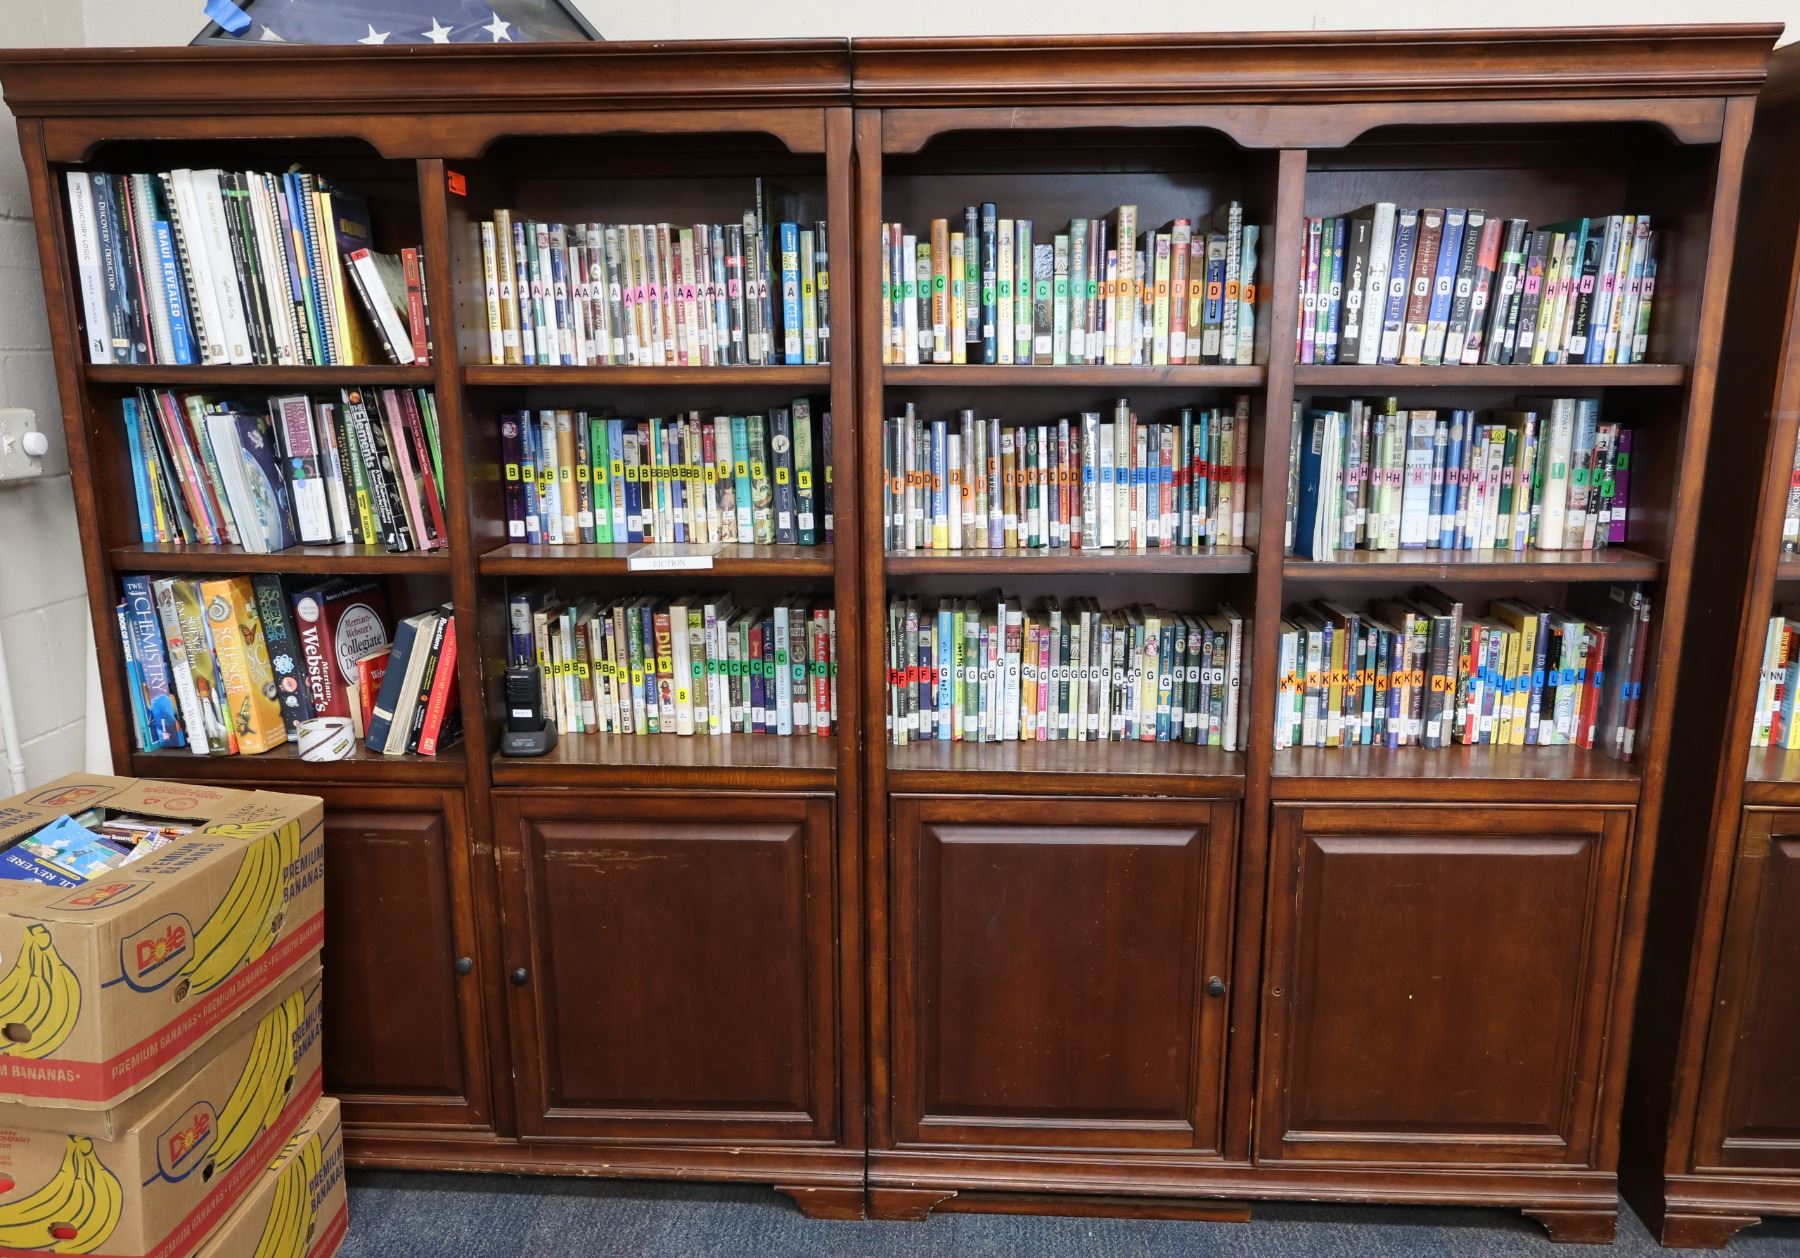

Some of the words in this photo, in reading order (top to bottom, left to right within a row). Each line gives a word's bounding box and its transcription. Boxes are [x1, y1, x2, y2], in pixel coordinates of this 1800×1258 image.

[75, 183, 88, 238] INTRODUCTORY
[1398, 229, 1411, 272] SHADOW
[1462, 230, 1478, 272] BRINGER
[158, 230, 169, 259] MAUI
[164, 263, 180, 317] REVEALED
[732, 283, 738, 293] A
[906, 285, 912, 294] C
[1001, 285, 1008, 293] C
[1088, 285, 1096, 294] C
[1175, 284, 1182, 293] D
[1230, 285, 1237, 294] D
[1372, 282, 1380, 291] G
[1440, 281, 1447, 290] G
[1506, 281, 1512, 290] G
[1562, 282, 1568, 291] H
[1632, 282, 1639, 291] H
[503, 286, 510, 296] A
[557, 287, 563, 296] A
[593, 286, 600, 295] A
[637, 290, 644, 300] A
[686, 289, 693, 299] A
[787, 287, 794, 297] A
[1040, 286, 1047, 295] C
[1146, 291, 1152, 301] D
[1320, 298, 1327, 307] G
[1509, 305, 1518, 324] RIVER
[1576, 314, 1586, 330] Night
[346, 424, 357, 452] FALLACY
[354, 411, 375, 468] Elements
[351, 453, 362, 486] DETECTIVE
[615, 464, 620, 472] B
[686, 468, 692, 477] B
[721, 465, 727, 474] B
[1200, 464, 1207, 473] F
[1361, 468, 1368, 476] H
[525, 469, 531, 478] B
[562, 470, 568, 478] B
[664, 469, 669, 478] B
[779, 471, 786, 480] B
[907, 473, 914, 482] D
[924, 474, 931, 482] D
[1007, 473, 1013, 482] D
[1061, 472, 1067, 481] D
[1104, 471, 1110, 479] E
[1151, 472, 1157, 481] E
[1386, 472, 1392, 481] H
[1434, 472, 1440, 481] H
[1472, 473, 1479, 481] H
[1505, 471, 1511, 480] H
[1577, 473, 1583, 482] J
[963, 488, 969, 497] D
[1605, 485, 1611, 494] J
[267, 590, 286, 640] SCIENCE
[118, 613, 126, 630] BOOK
[345, 616, 371, 628] Merriam-
[121, 631, 127, 639] OF
[346, 624, 372, 637] Webster's
[433, 617, 447, 650] Reactions
[176, 601, 196, 670] ENCYCLOPEDIA
[134, 597, 167, 693] CHEMISTRY
[341, 635, 381, 657] Collegiate
[220, 627, 244, 692] SCIENCE
[303, 626, 326, 712] Webster's
[555, 666, 560, 674] B
[580, 667, 586, 675] B
[610, 665, 615, 674] B
[647, 663, 652, 671] B
[694, 666, 700, 675] C
[732, 663, 738, 672] C
[766, 666, 773, 675] C
[809, 663, 815, 672] C
[1010, 667, 1016, 676] G
[908, 669, 914, 678] F
[969, 671, 976, 680] G
[1040, 672, 1047, 680] G
[1081, 670, 1087, 679] G
[1115, 672, 1121, 681] G
[1214, 672, 1221, 681] G
[1288, 674, 1294, 682] K
[1333, 673, 1339, 682] K
[1356, 674, 1361, 682] K
[1405, 674, 1410, 682] K
[321, 661, 331, 702] Merriam-
[1163, 678, 1169, 687] G
[1488, 674, 1494, 683] L
[1536, 675, 1542, 684] L
[1446, 682, 1452, 691] K
[1625, 687, 1630, 696] L
[158, 844, 224, 875] BANANAS
[283, 844, 323, 883] PREMIUM
[6, 855, 57, 880] REVERE
[283, 865, 323, 902] BANANAS
[137, 925, 185, 971] Dole
[112, 1041, 158, 1079] PREMIUM
[160, 1017, 198, 1048] BANANAS
[203, 984, 235, 1016] PREMIUM
[236, 964, 267, 994] BANANAS
[271, 940, 298, 965] PREMIUM
[12, 1065, 75, 1082] BANANAS
[169, 1111, 209, 1164] Dole
[309, 1146, 343, 1193] PREMIUM
[310, 1166, 344, 1213] BANANAS
[191, 1192, 225, 1231] BANANAS
[228, 1161, 253, 1192] PREMIUM
